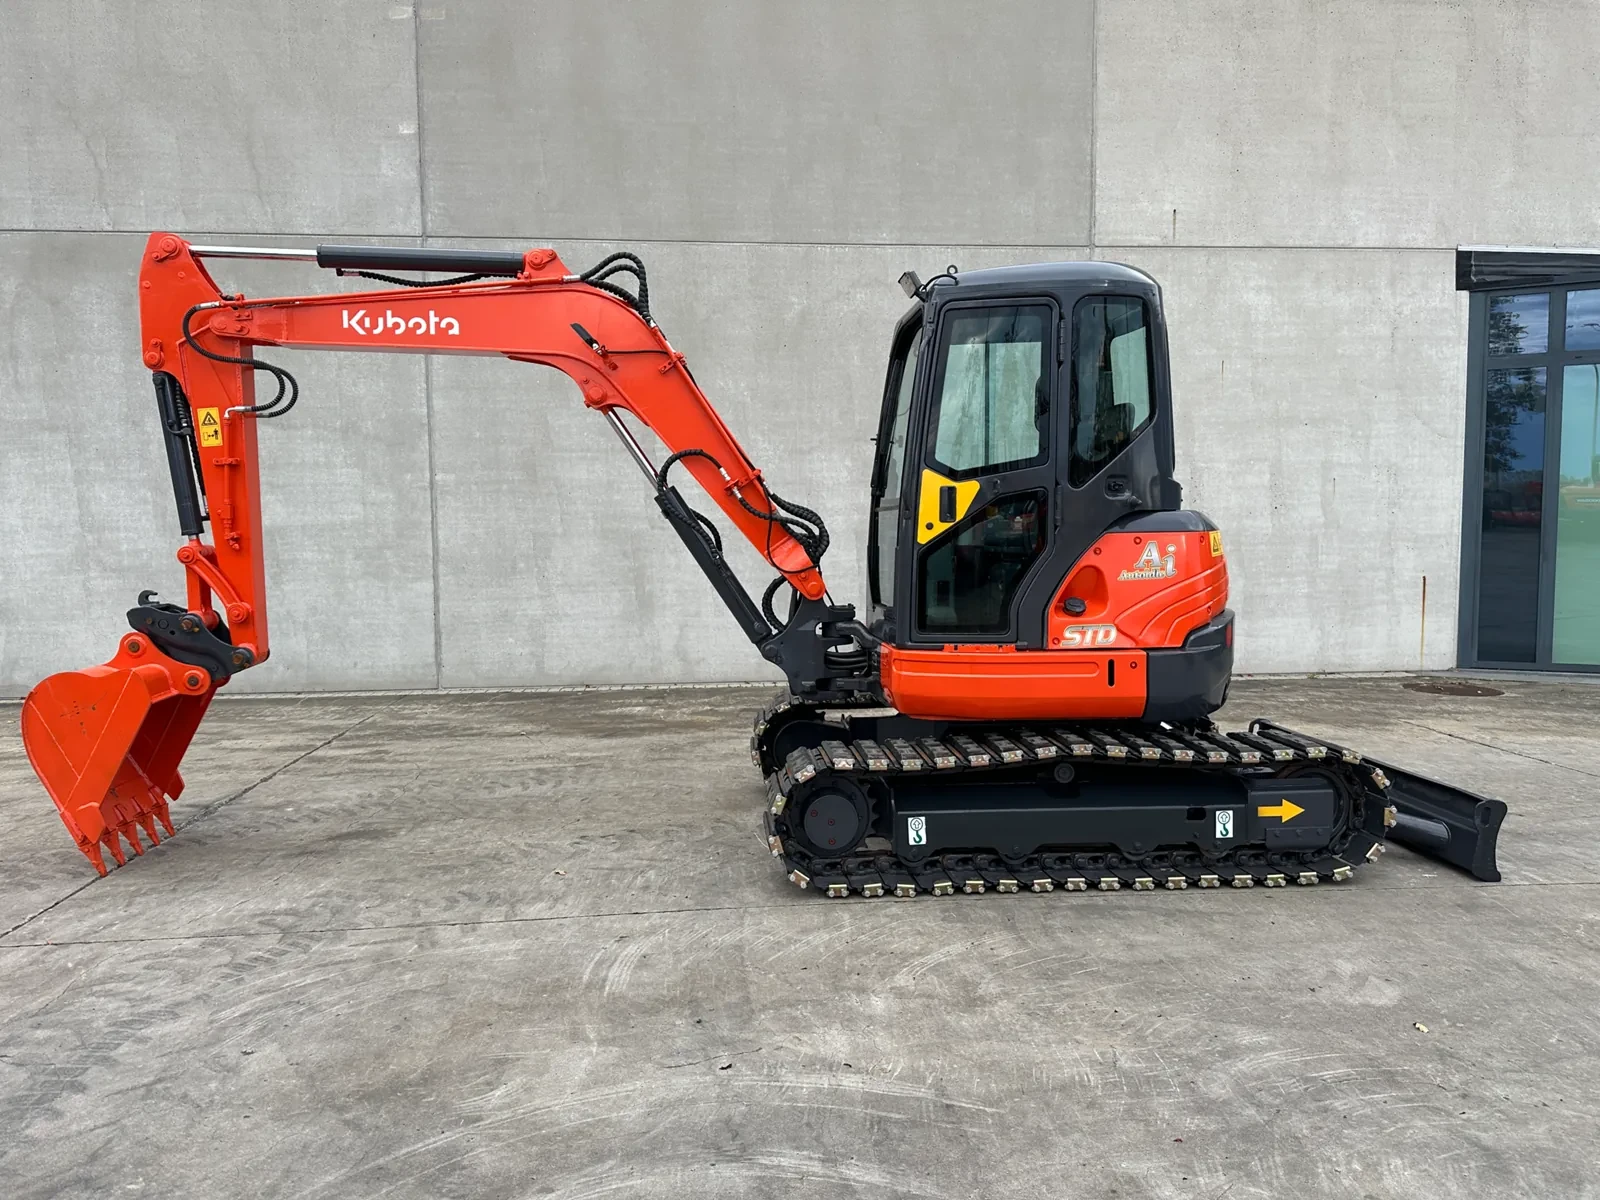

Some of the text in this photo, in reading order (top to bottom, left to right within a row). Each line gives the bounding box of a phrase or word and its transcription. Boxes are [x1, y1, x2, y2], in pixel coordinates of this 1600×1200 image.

[342, 309, 460, 335] Kubota
[1134, 541, 1176, 578] Ai
[1061, 624, 1117, 647] STD
